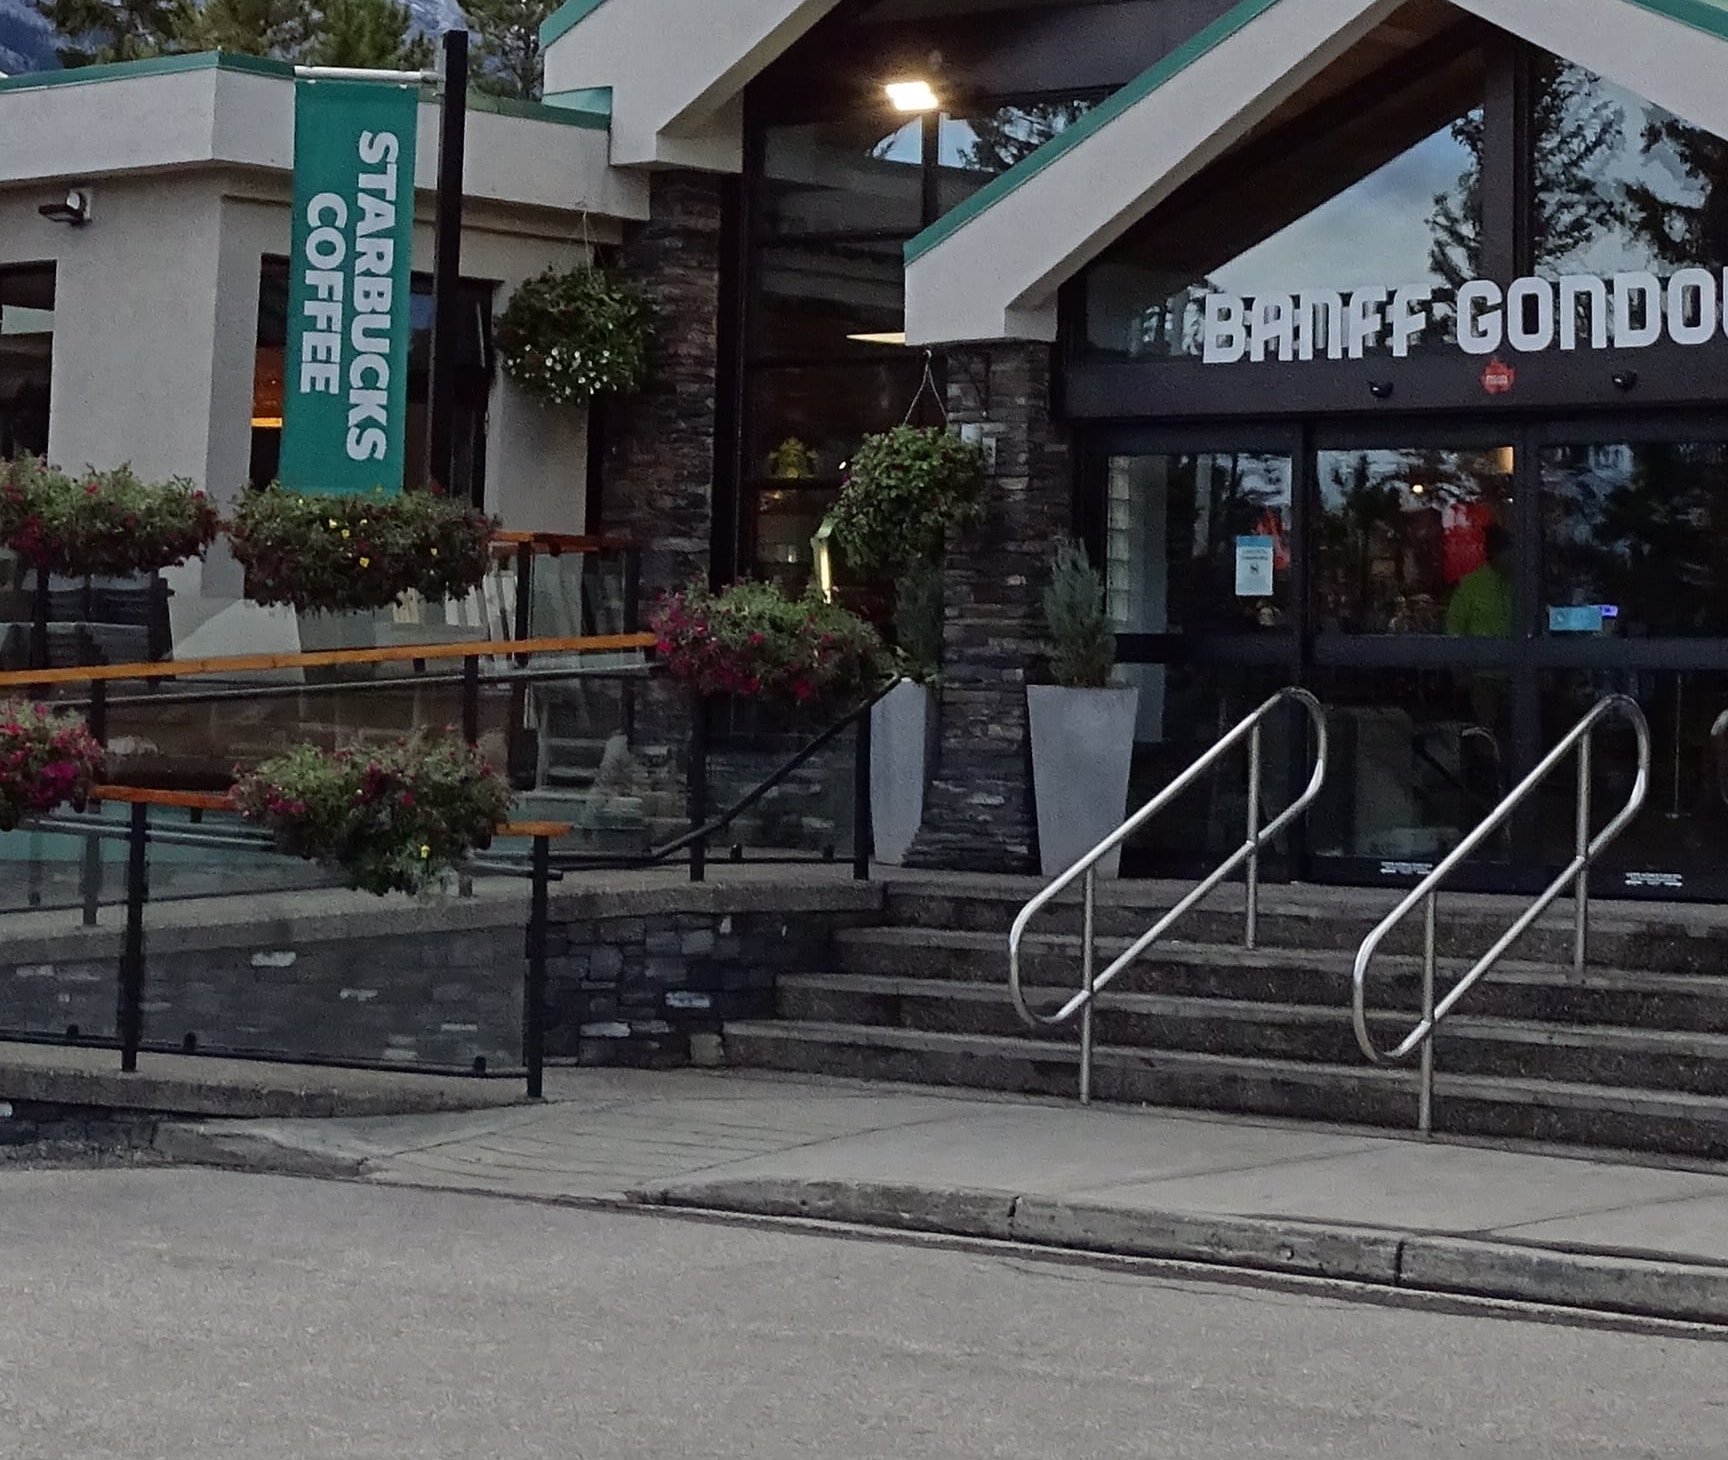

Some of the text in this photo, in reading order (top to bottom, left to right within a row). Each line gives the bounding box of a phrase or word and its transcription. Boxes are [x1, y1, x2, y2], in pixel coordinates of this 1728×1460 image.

[300, 192, 348, 395] COFFEE
[346, 130, 399, 461] STARBUCKS
[1203, 285, 1432, 364] BANFF
